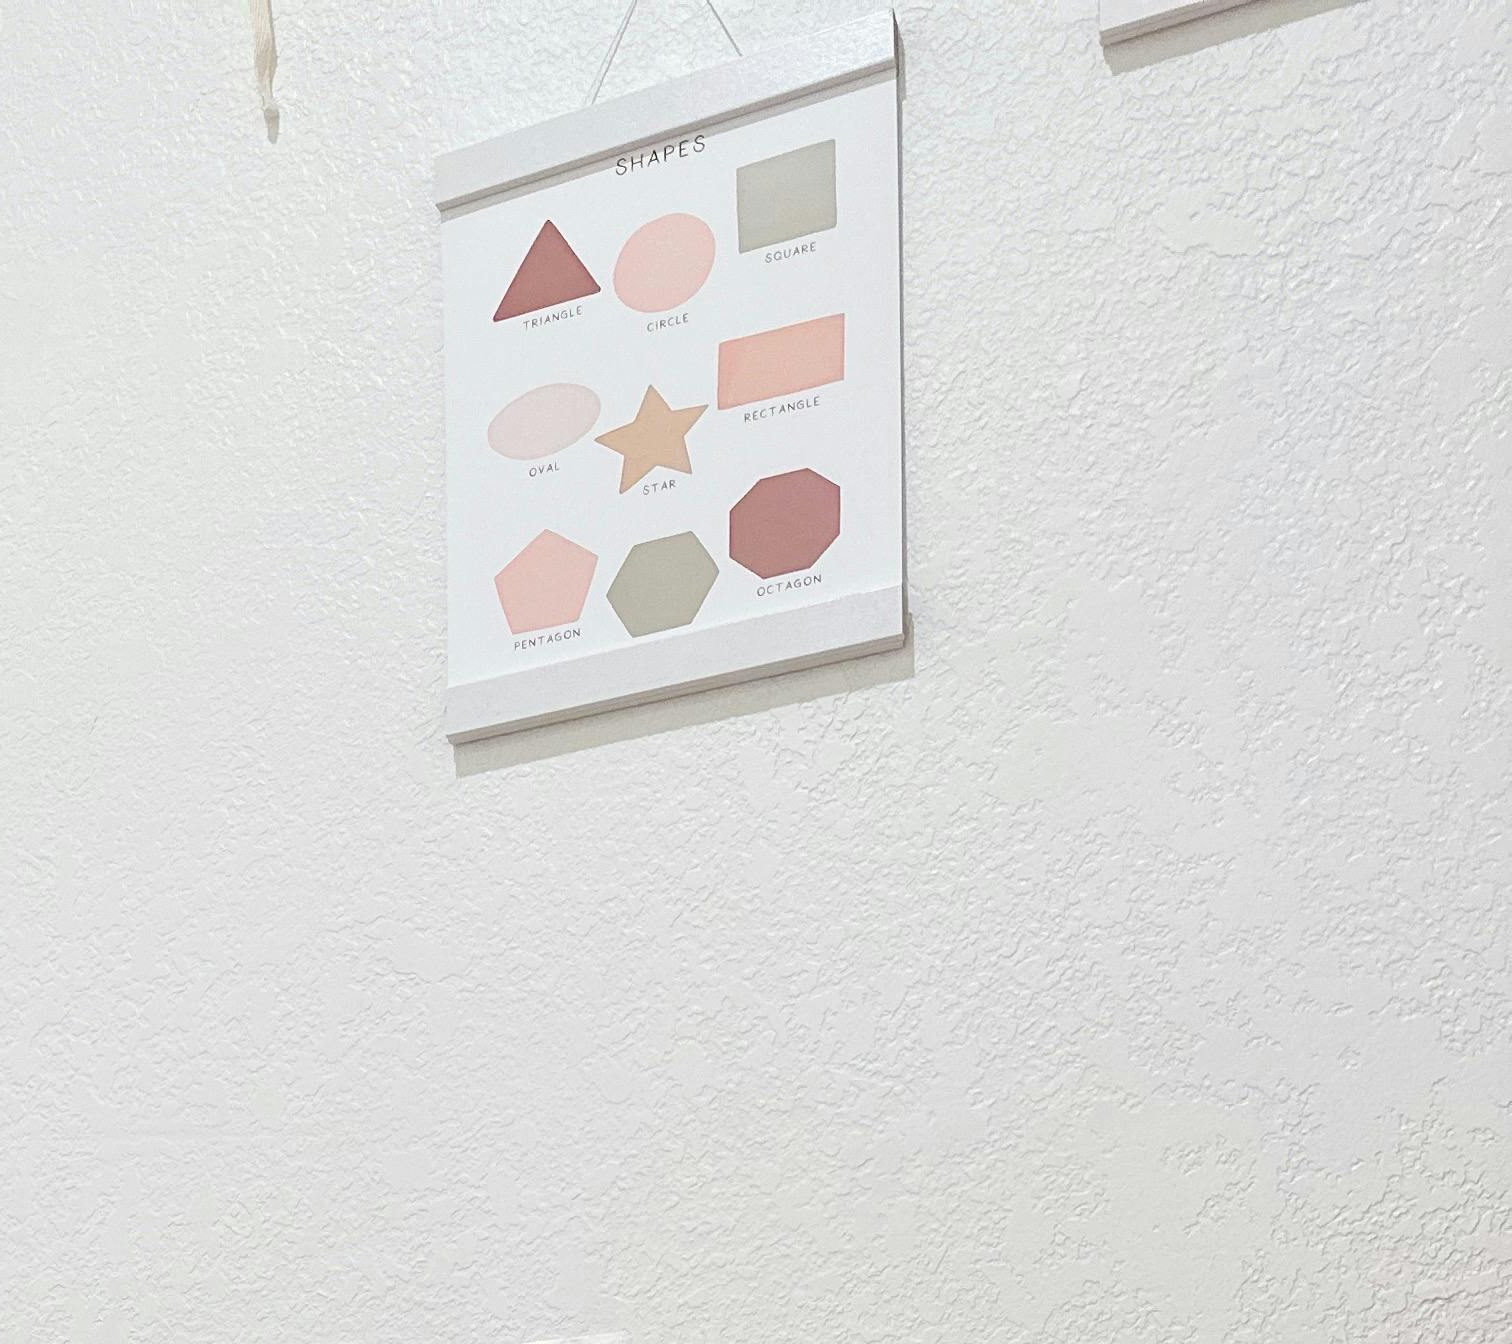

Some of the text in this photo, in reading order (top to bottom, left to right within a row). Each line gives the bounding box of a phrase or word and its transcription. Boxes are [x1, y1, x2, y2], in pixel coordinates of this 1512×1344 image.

[615, 135, 707, 176] SHAPES
[523, 242, 817, 333] TRIANGLE CIRCLE SQUARE
[528, 396, 821, 496] OVAL STAR RECTANGLE
[513, 574, 823, 652] PENTAGON OCTAGON
